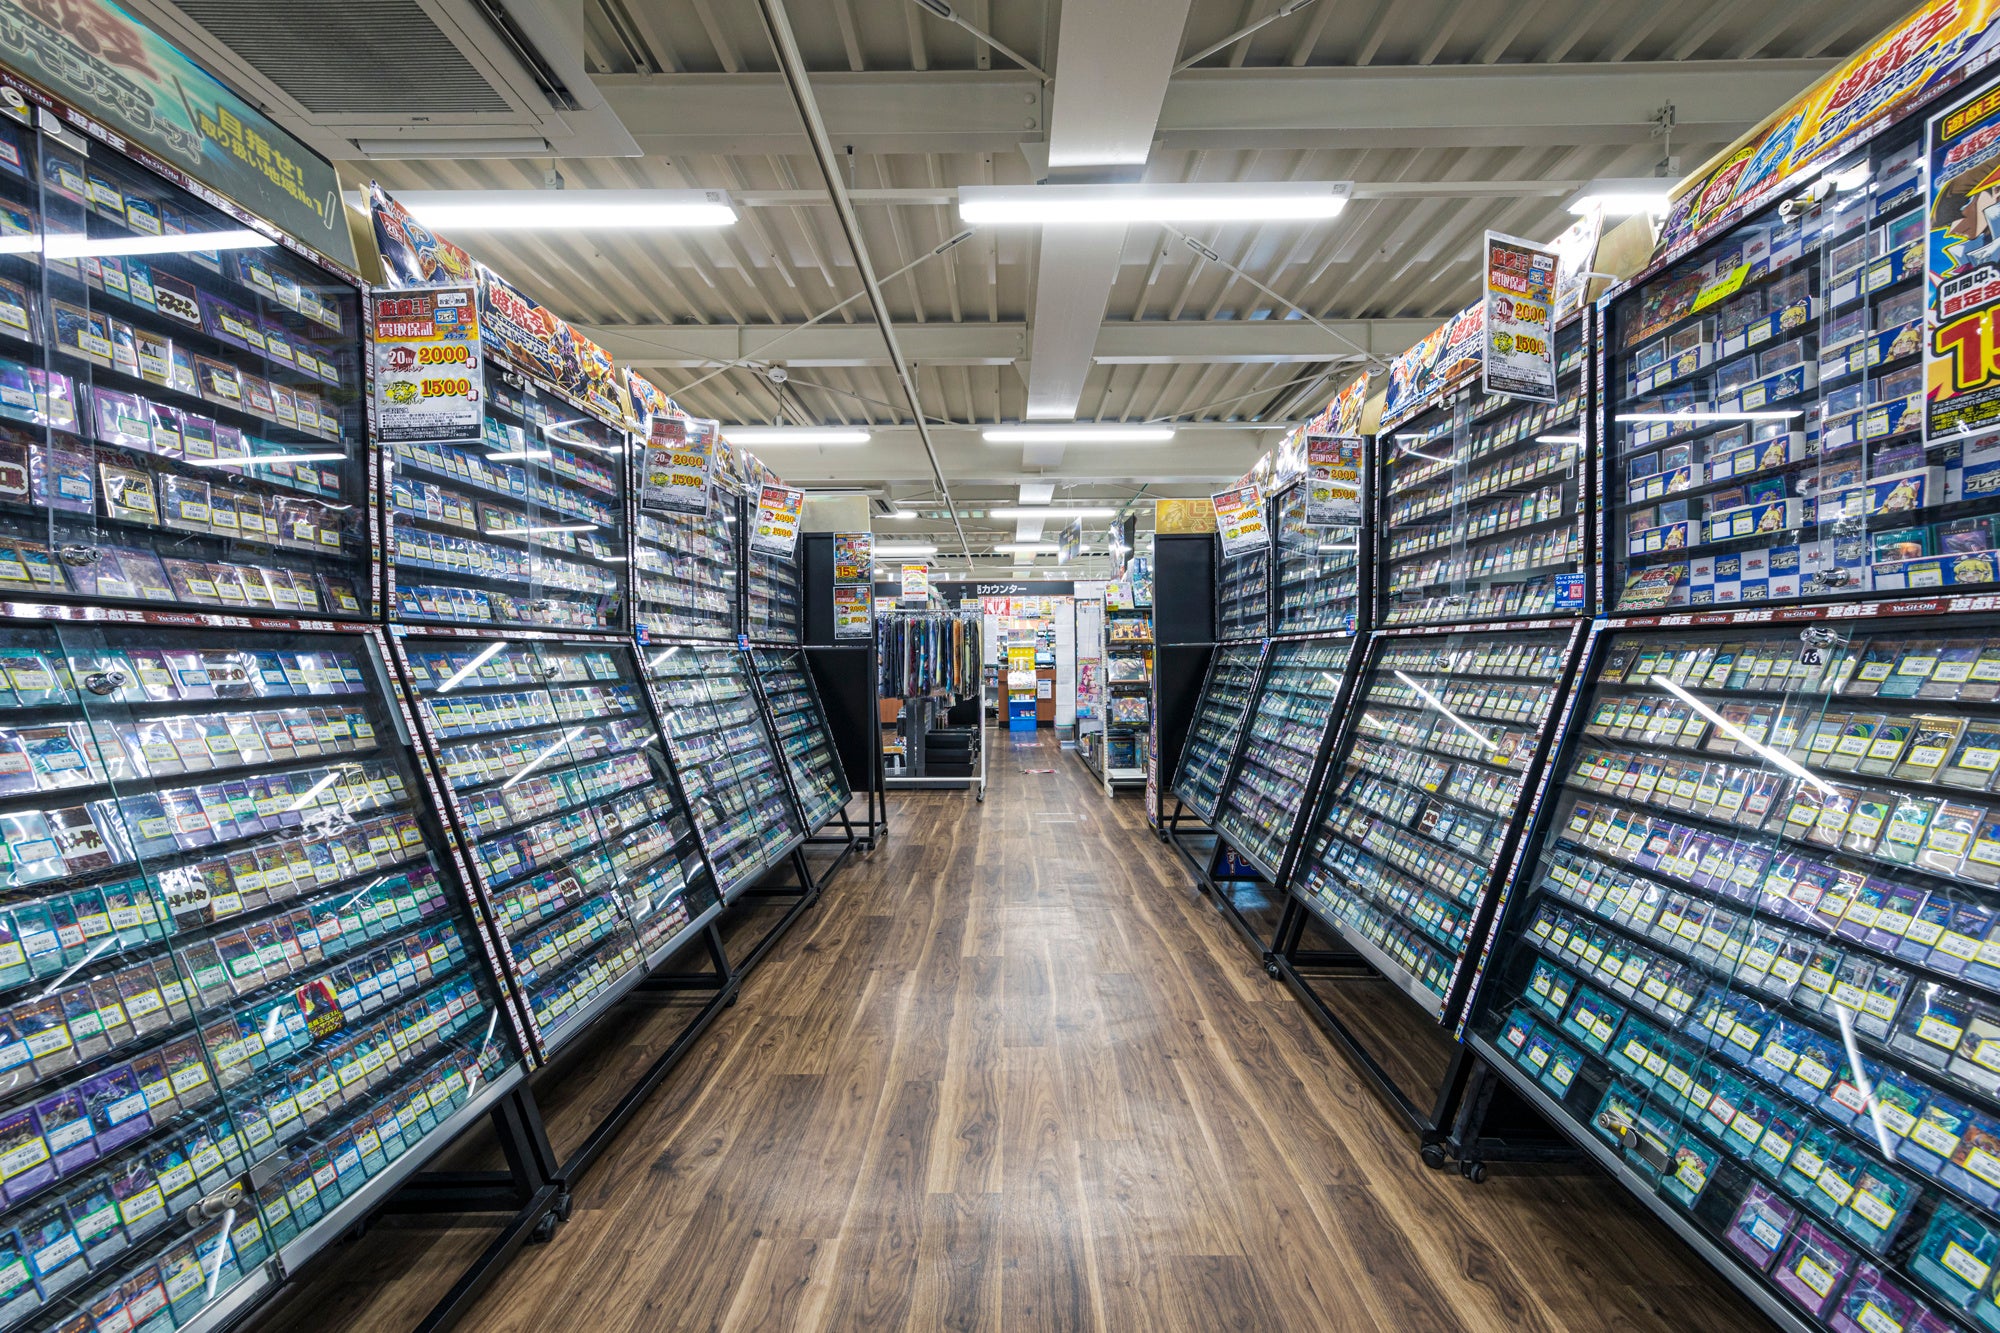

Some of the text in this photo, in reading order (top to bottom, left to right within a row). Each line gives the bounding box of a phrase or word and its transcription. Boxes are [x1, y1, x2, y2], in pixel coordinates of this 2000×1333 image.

[1819, 0, 1961, 120] 遊戯王
[1790, 28, 1970, 167] デュエルモンスターズ
[379, 297, 432, 318] 遊戯王
[490, 284, 549, 337] 遊戯王
[379, 322, 434, 337] 買取保証
[1826, 604, 1879, 618] 遊戯王
[1892, 602, 1938, 612] Yu-Gi-Oh!
[1660, 616, 1692, 626] 遊戯王
[1733, 611, 1774, 623] 遊戯王
[299, 620, 335, 631] 遊戯王
[1803, 652, 1819, 662] 13
